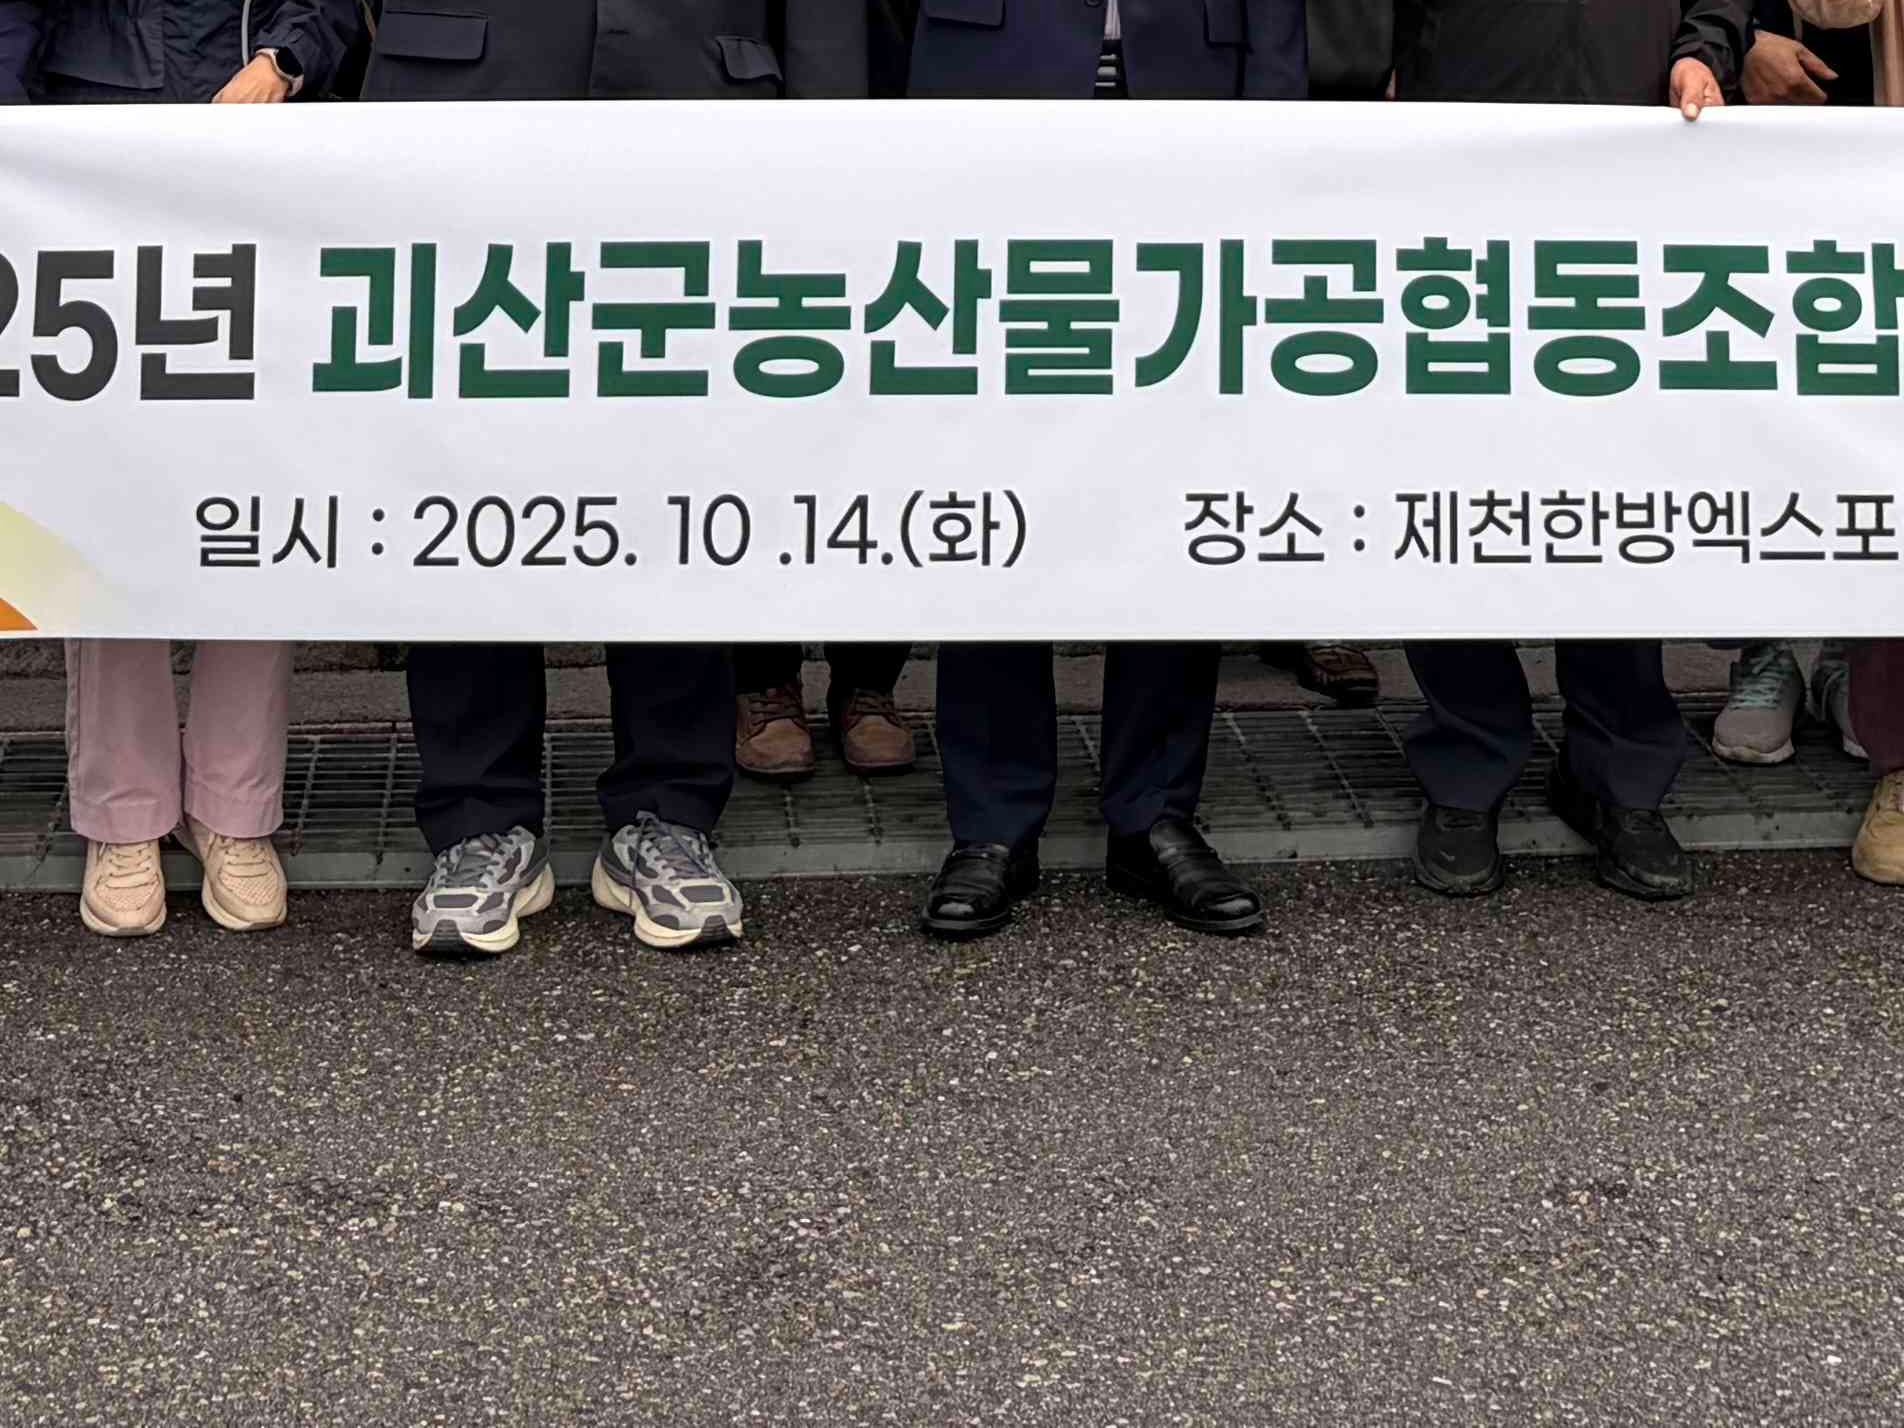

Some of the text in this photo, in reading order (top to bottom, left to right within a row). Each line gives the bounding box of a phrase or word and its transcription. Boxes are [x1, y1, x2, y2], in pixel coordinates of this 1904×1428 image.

[196, 495, 338, 569] 일시
[413, 495, 637, 568] 2025.
[668, 494, 751, 566] 10
[1185, 491, 1325, 566] 장소
